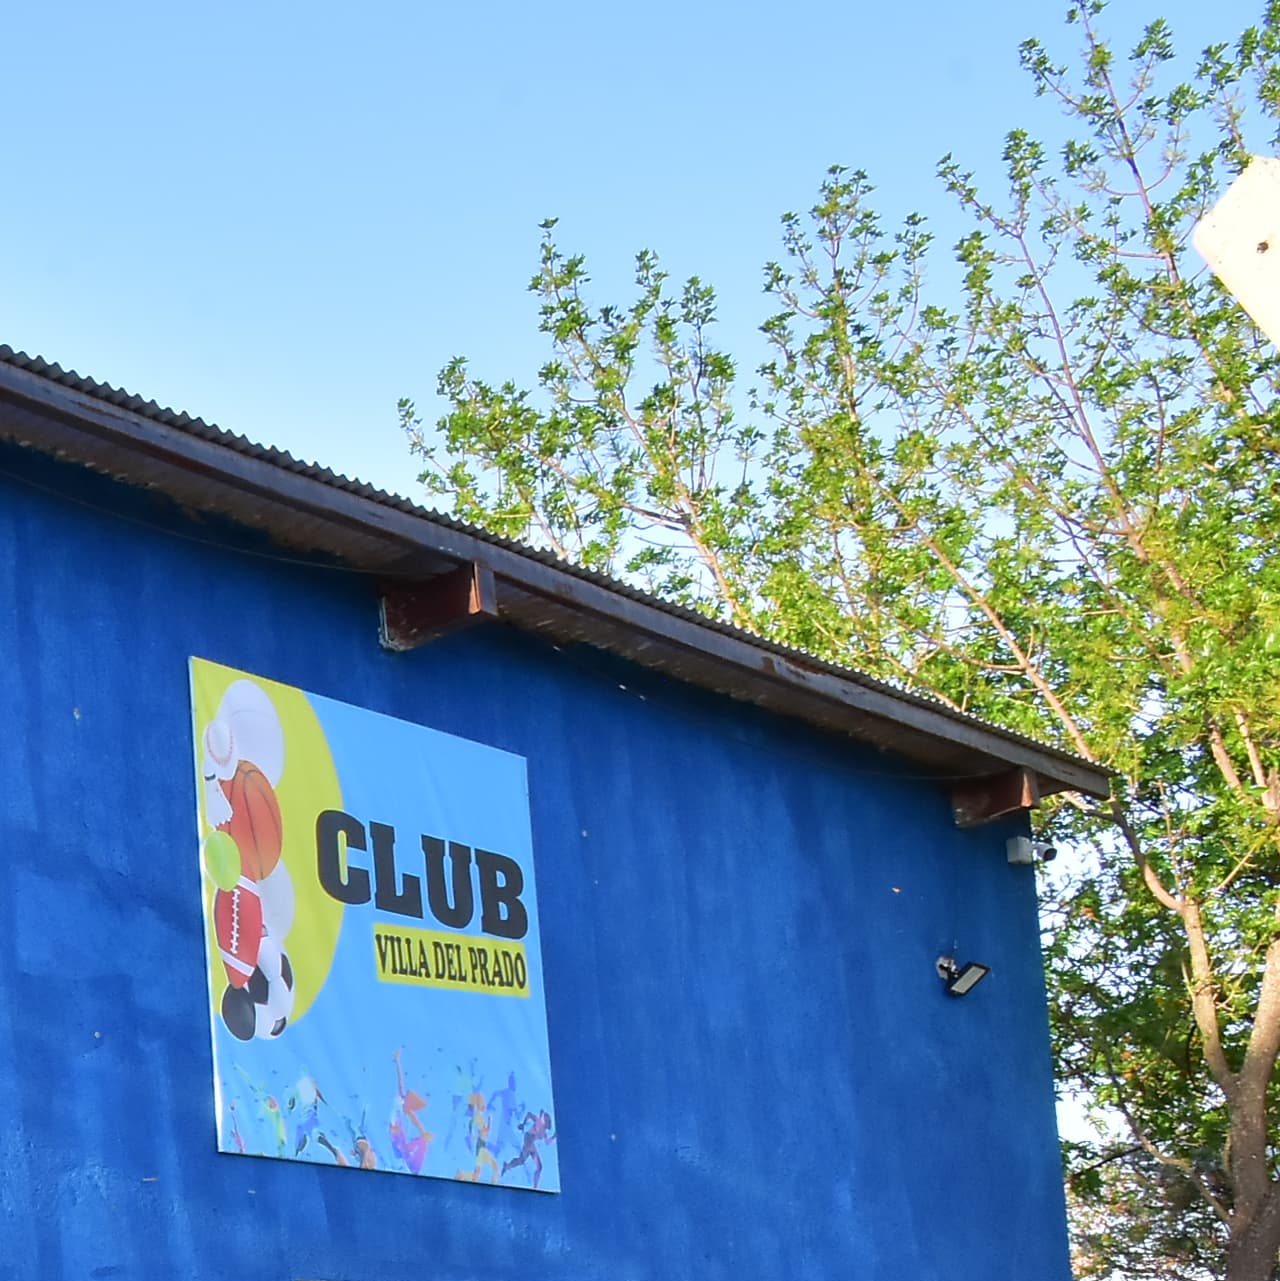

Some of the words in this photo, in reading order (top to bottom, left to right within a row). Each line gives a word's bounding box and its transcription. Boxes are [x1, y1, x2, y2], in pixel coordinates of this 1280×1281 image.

[316, 809, 529, 940] CLUB
[375, 934, 431, 978] VILLA
[432, 941, 467, 982] DEL
[468, 946, 527, 989] PRADO
